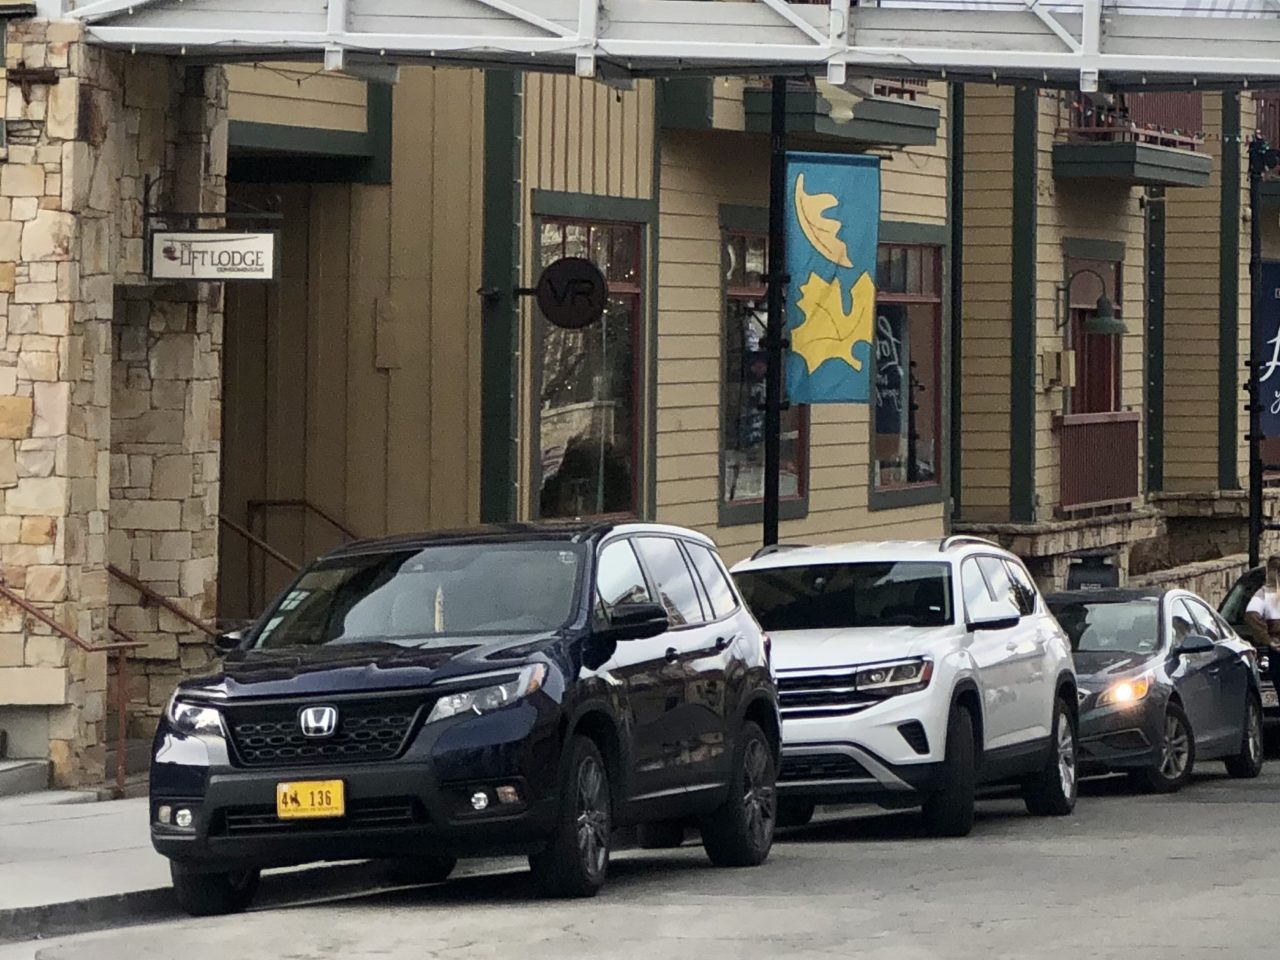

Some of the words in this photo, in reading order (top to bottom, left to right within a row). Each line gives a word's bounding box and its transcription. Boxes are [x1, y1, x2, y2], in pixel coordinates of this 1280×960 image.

[210, 251, 264, 266] LODGE
[545, 279, 595, 307] VR
[282, 791, 289, 808] 4
[310, 790, 332, 807] 136
